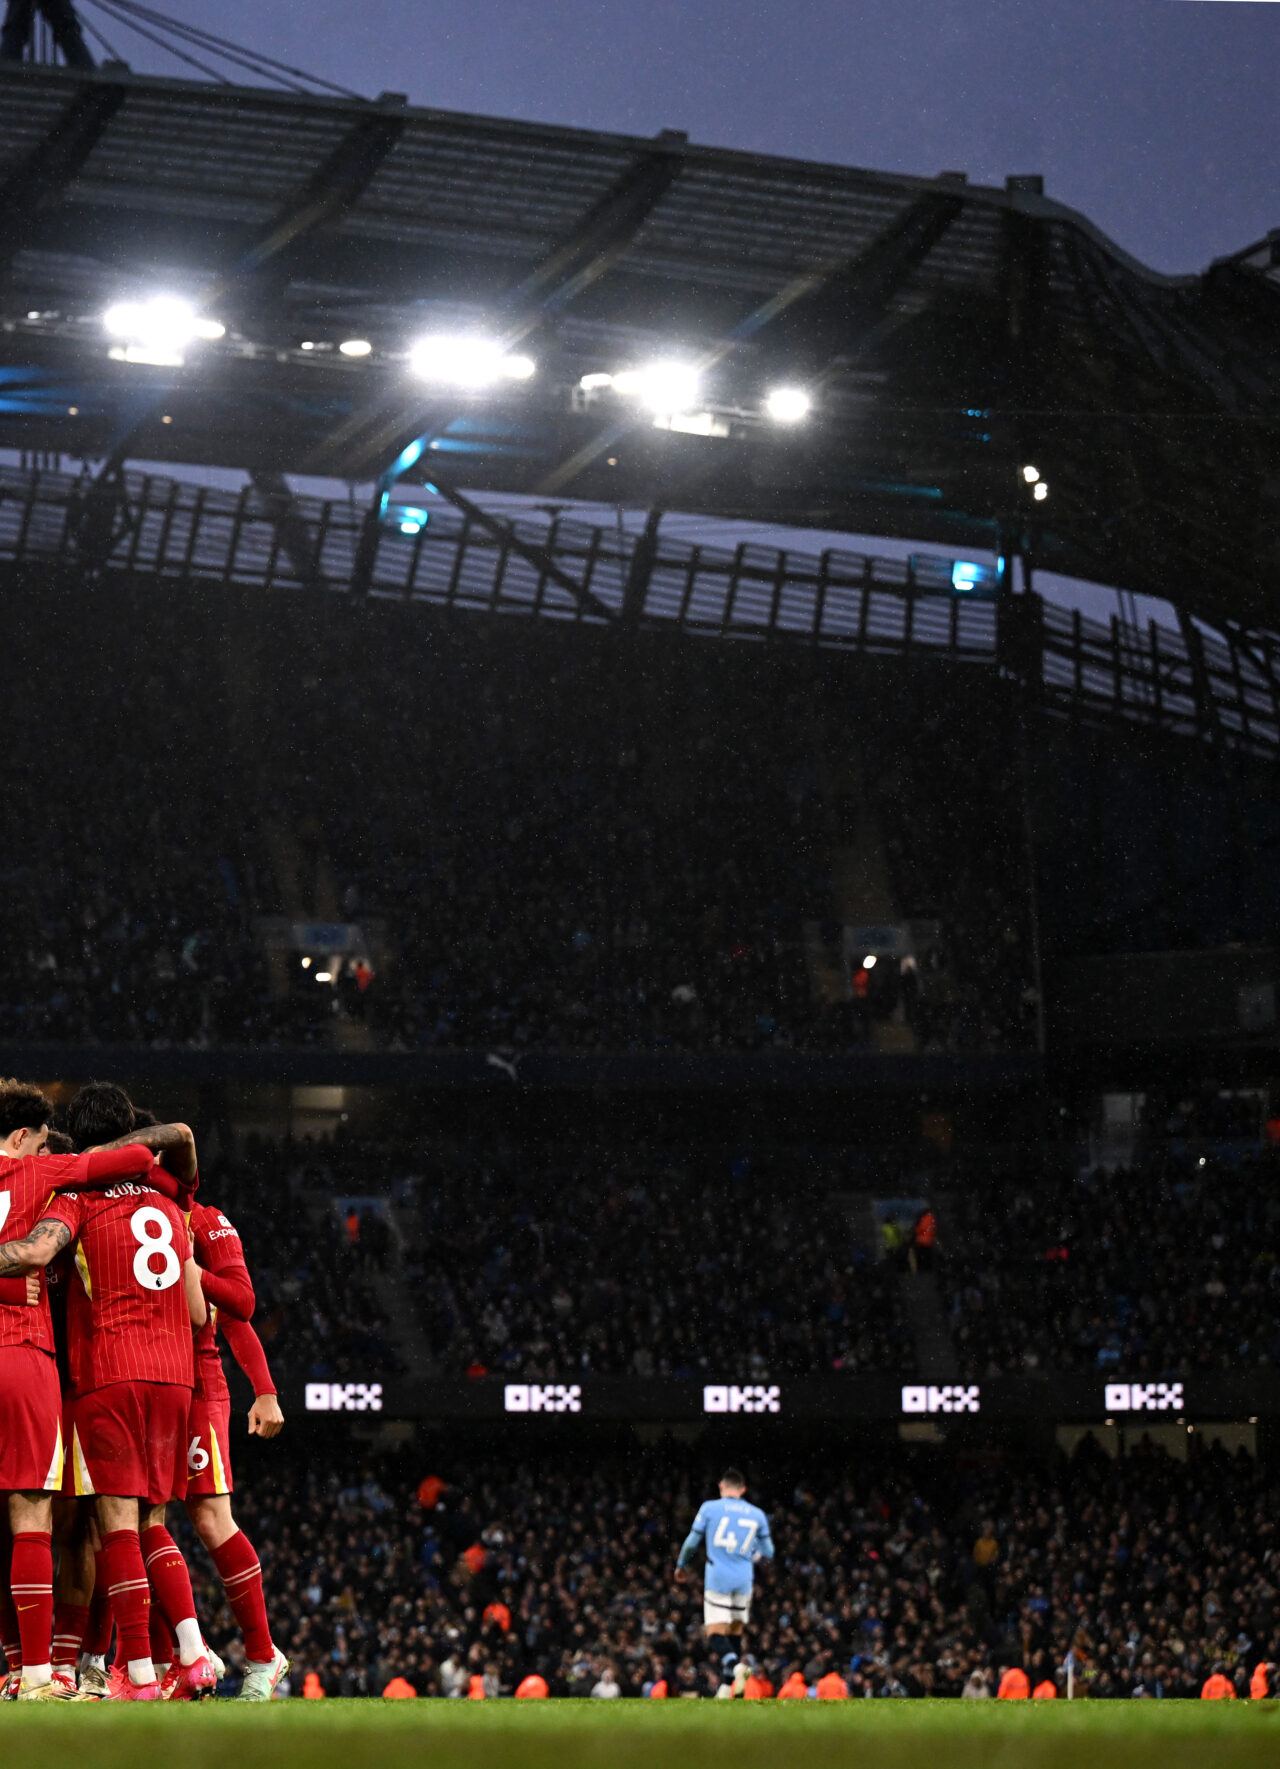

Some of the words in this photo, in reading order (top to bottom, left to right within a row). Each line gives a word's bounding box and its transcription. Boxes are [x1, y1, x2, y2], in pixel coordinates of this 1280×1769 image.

[130, 1206, 181, 1291] 8
[306, 1383, 382, 1410] OKX
[505, 1385, 581, 1411] OKX
[704, 1386, 780, 1412] OKX
[902, 1386, 979, 1412] OKX
[1105, 1383, 1183, 1410] OKX
[713, 1516, 759, 1556] 47
[166, 1560, 185, 1568] LFC
